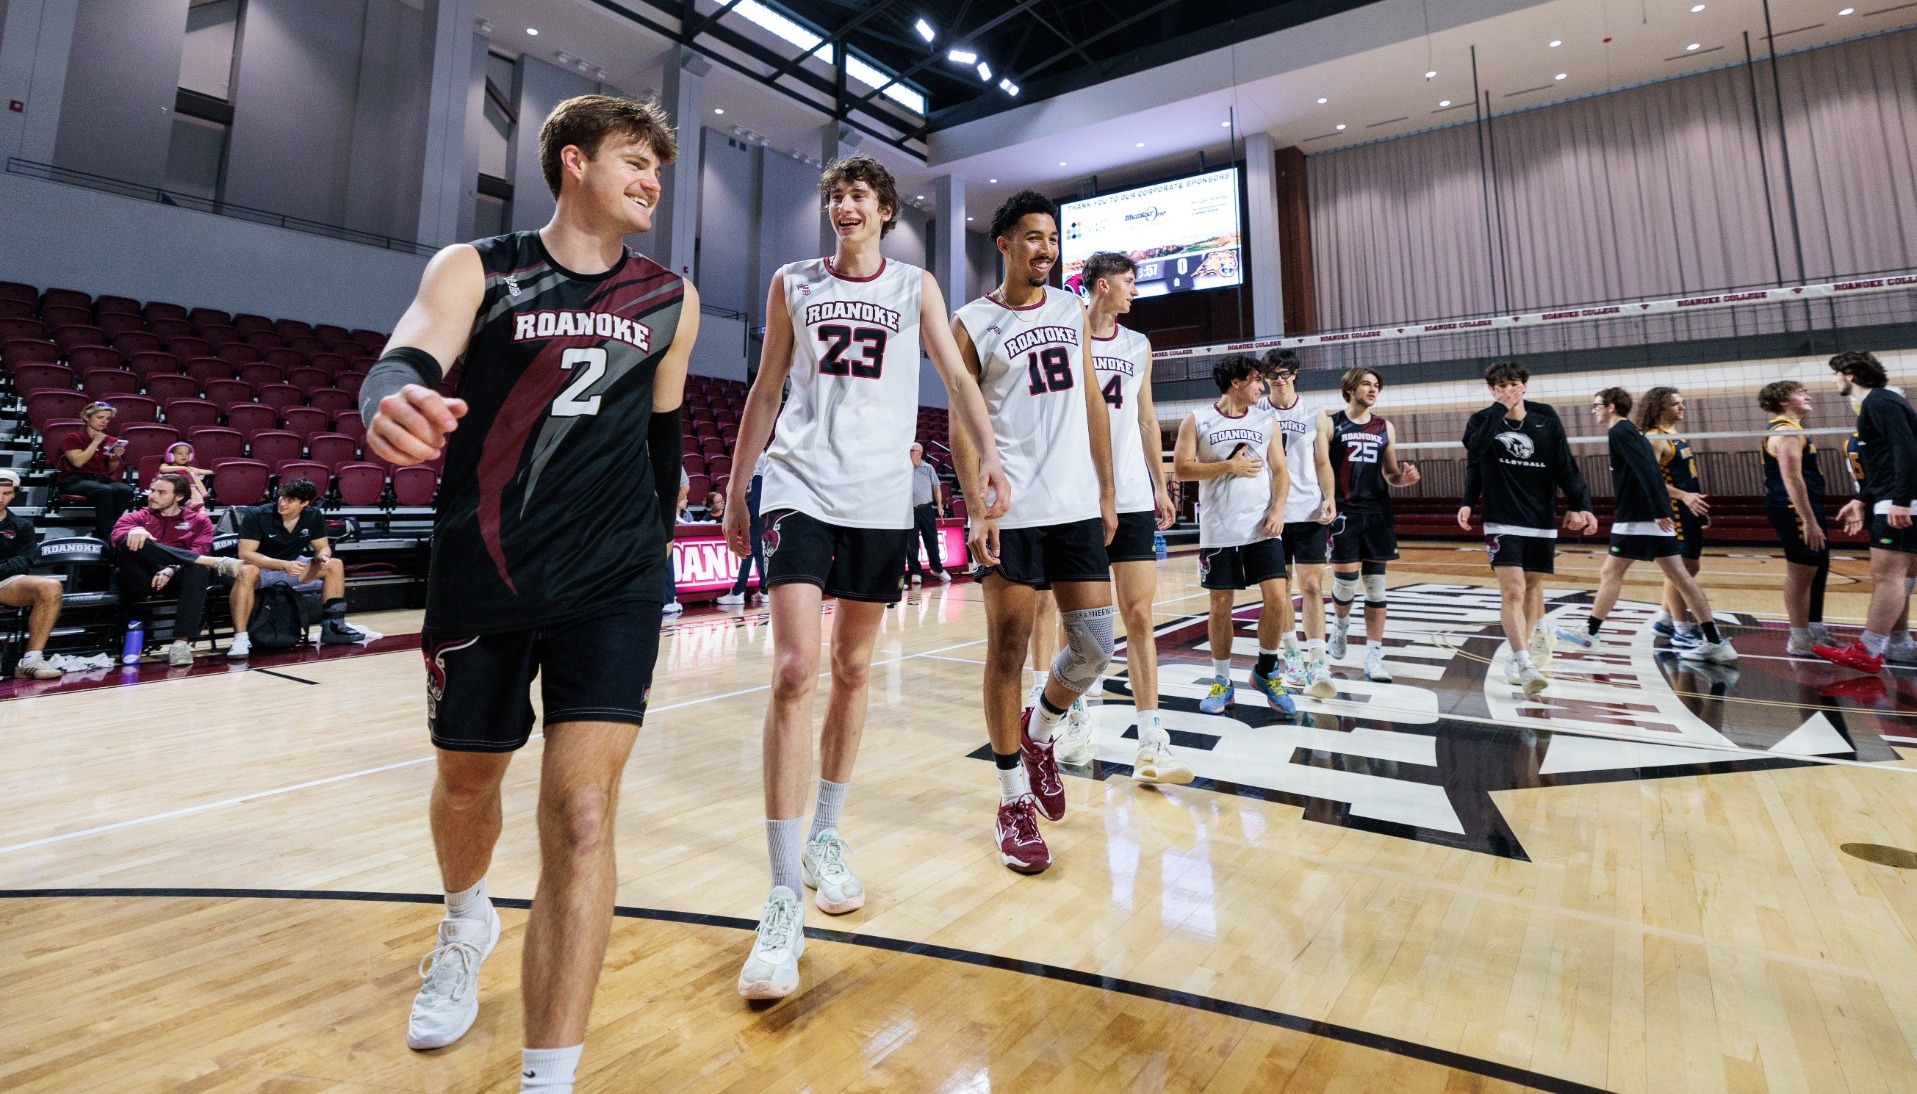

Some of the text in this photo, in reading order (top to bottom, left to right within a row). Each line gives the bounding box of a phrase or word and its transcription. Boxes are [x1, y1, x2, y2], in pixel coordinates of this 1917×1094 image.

[1068, 203, 1091, 212] THANK
[1121, 192, 1136, 201] OUR
[1138, 182, 1184, 198] CORPORATE
[1186, 172, 1230, 188] SPONSORS
[1834, 276, 1917, 291] ROANOKE COLL
[1677, 292, 1767, 307] ROANOKE COLLEGE
[806, 301, 899, 333] ROANOKE
[1542, 306, 1620, 321] ROANOKE COLLEGE
[513, 310, 652, 353] ROANOKE
[1424, 319, 1493, 332] ROANOKE COLLEGE
[1004, 325, 1078, 360] ROANOKE
[1320, 330, 1381, 342] ROANOKE COLLEGE
[818, 324, 887, 379] 23
[1227, 340, 1282, 351] ROANOKE COLLEGE
[1028, 346, 1074, 396] 18
[551, 347, 608, 417] 2
[1210, 429, 1262, 445] ROANOKE
[1341, 432, 1383, 445] ROANOKE
[1347, 441, 1379, 463] 25
[42, 543, 102, 556] ROANOKE
